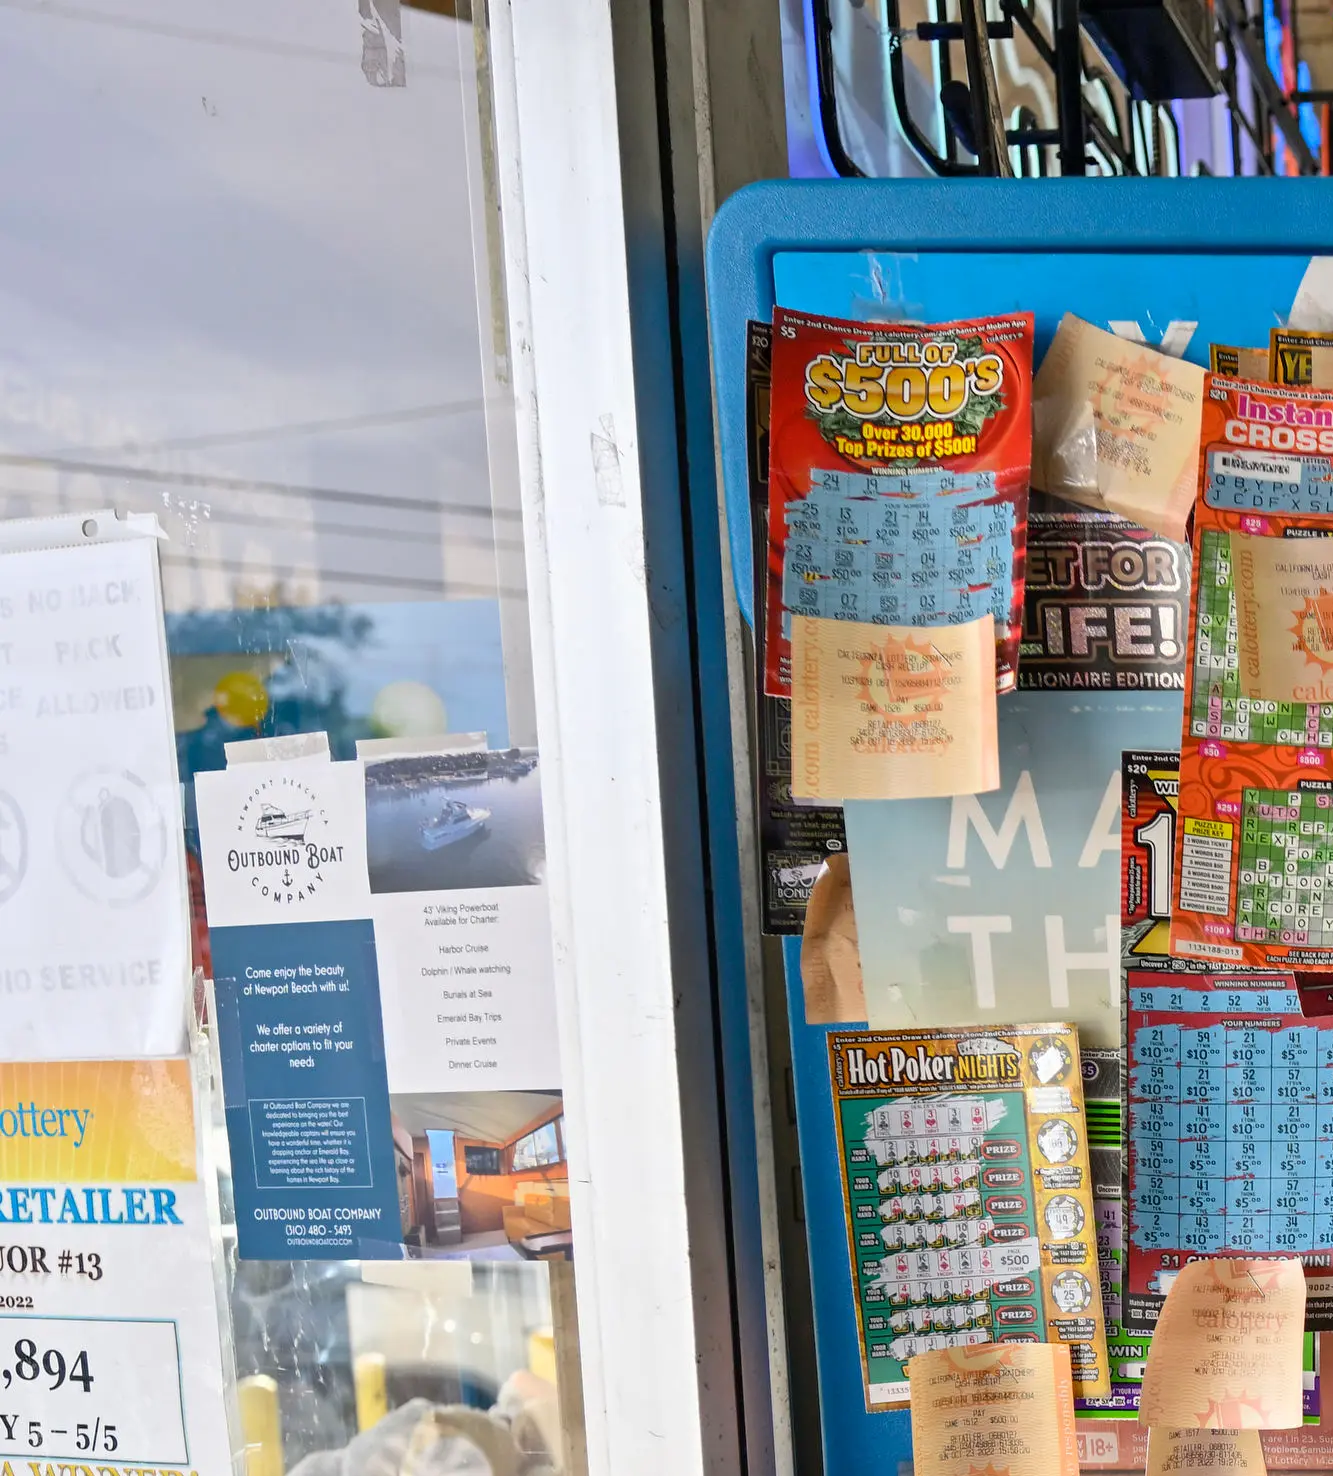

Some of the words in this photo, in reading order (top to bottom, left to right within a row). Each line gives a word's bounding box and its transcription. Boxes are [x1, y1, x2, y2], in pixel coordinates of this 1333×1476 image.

[780, 326, 797, 339] $5
[858, 343, 922, 364] FULL
[922, 343, 958, 363] OF
[805, 354, 1003, 419] $500'S
[862, 424, 897, 440] Over
[900, 422, 954, 441] 30,000
[836, 437, 862, 457] Top
[866, 440, 913, 459] Prizes
[916, 440, 931, 457] of
[934, 437, 977, 458] $500!
[228, 850, 300, 871] OUTBOUND
[306, 843, 343, 869] BOAT
[252, 872, 323, 903] COMPANY
[246, 967, 271, 978] Come
[274, 966, 297, 980] enjoy
[299, 965, 312, 976] the
[315, 964, 344, 976] beauty
[244, 984, 252, 995] of
[255, 984, 288, 997] Newport
[291, 981, 317, 993] Beach
[320, 980, 336, 992] with
[339, 980, 350, 991] us!
[1214, 980, 1248, 988] WINNING
[1250, 980, 1286, 988] NUMBERS
[257, 1024, 270, 1035] We
[273, 1023, 292, 1035] offer
[303, 1023, 330, 1035] variety
[333, 1021, 342, 1033] of
[250, 1041, 279, 1052] charter
[281, 1040, 310, 1053] options
[313, 1040, 322, 1050] to
[324, 1039, 332, 1049] fit
[335, 1041, 353, 1052] your
[290, 1056, 314, 1068] needs
[847, 1048, 889, 1085] Hot
[889, 1046, 953, 1082] Poker
[957, 1053, 1018, 1080] NIGHTS
[0, 1188, 183, 1225] ETAILER
[254, 1208, 305, 1220] OUTBOUND
[308, 1208, 331, 1220] BOAT
[335, 1208, 381, 1220] COMPANY
[286, 1226, 306, 1236] (310)
[308, 1225, 326, 1235] 480
[334, 1225, 352, 1235] 5493
[58, 1250, 103, 1281] #13
[28, 1422, 43, 1447] 5
[76, 1417, 118, 1451] 5/5
